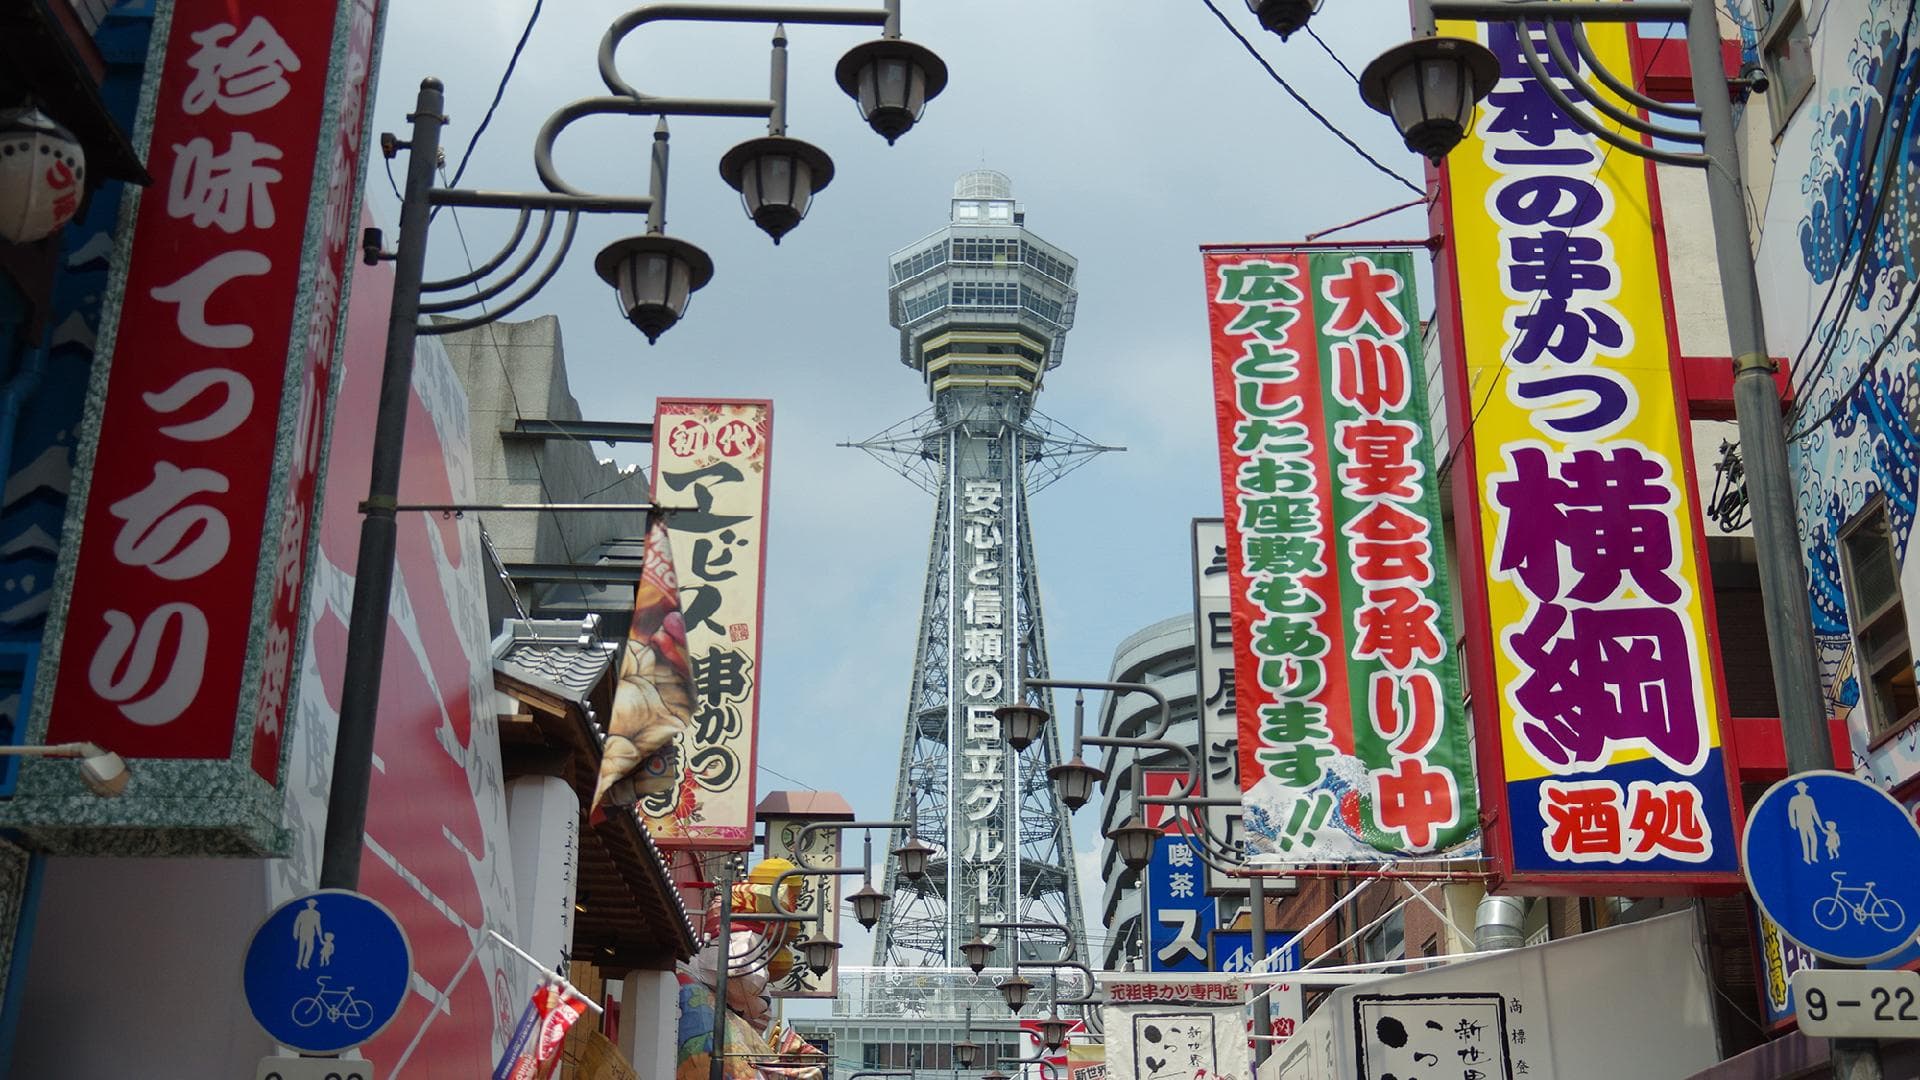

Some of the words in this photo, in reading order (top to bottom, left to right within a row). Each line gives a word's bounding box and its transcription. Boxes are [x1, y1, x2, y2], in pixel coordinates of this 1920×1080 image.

[1486, 20, 1628, 432] 日本一の串かつ
[668, 420, 757, 457] 初代
[1326, 260, 1453, 848] 大小宴会承り中
[1495, 446, 1700, 765] 横綱
[1545, 783, 1707, 858] 酒処
[1168, 843, 1194, 899] 喫茶
[1222, 943, 1293, 972] Ashi
[1110, 984, 1238, 1001] 元祖串カツ専門店
